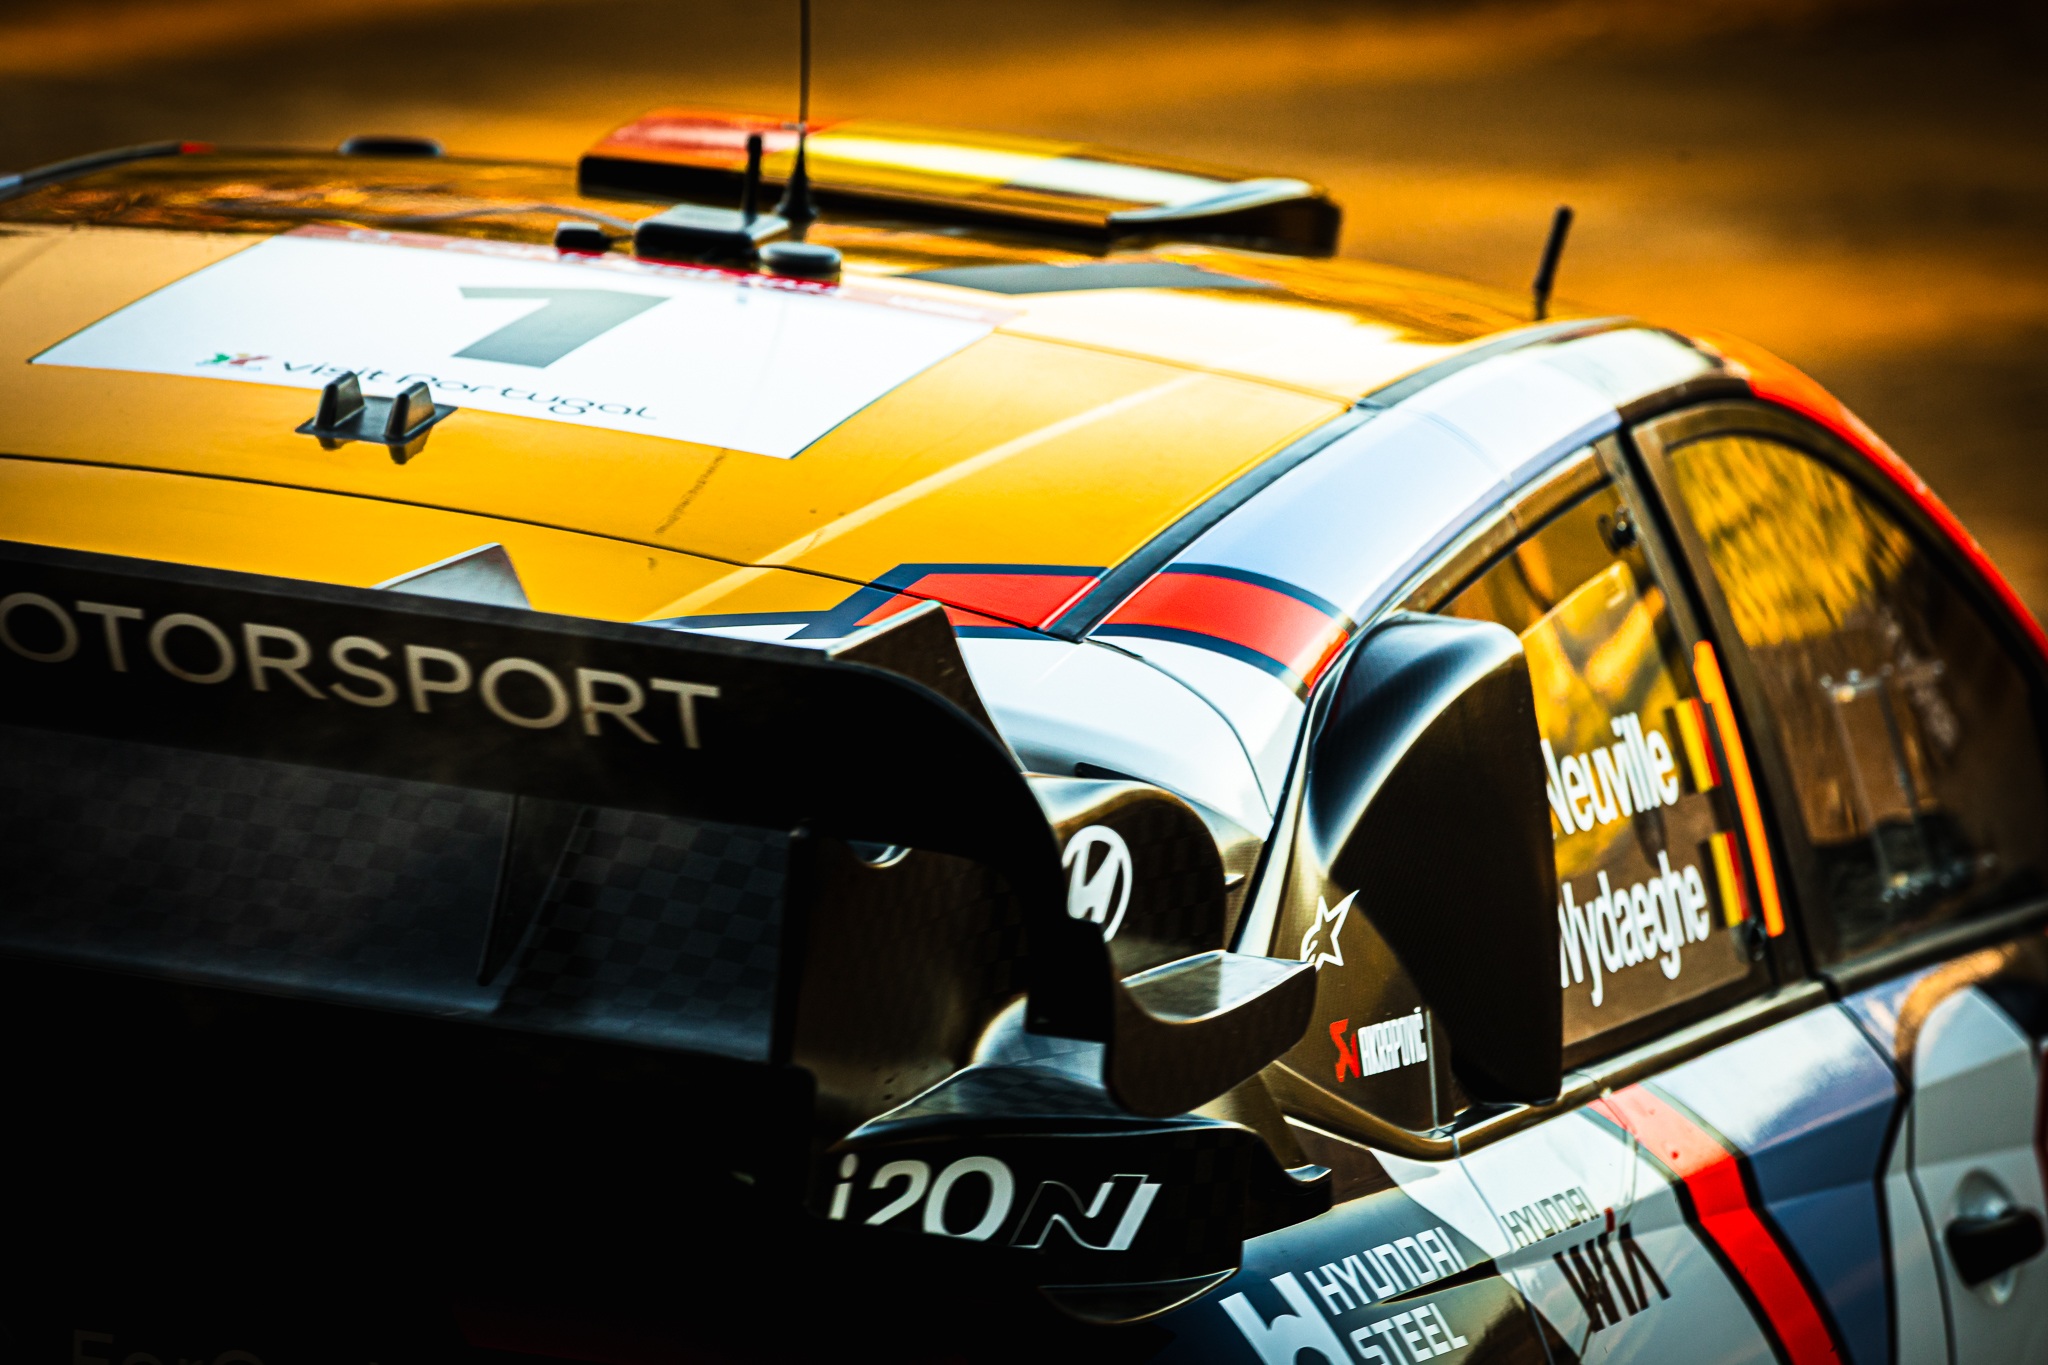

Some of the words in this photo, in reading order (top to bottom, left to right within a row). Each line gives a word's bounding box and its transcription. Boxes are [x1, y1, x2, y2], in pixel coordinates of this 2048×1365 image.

[453, 285, 672, 369] 1
[1500, 1186, 1600, 1248] HYUNDAI
[1304, 1226, 1468, 1316] HYUNDAI
[1349, 1302, 1469, 1365] STEEL
